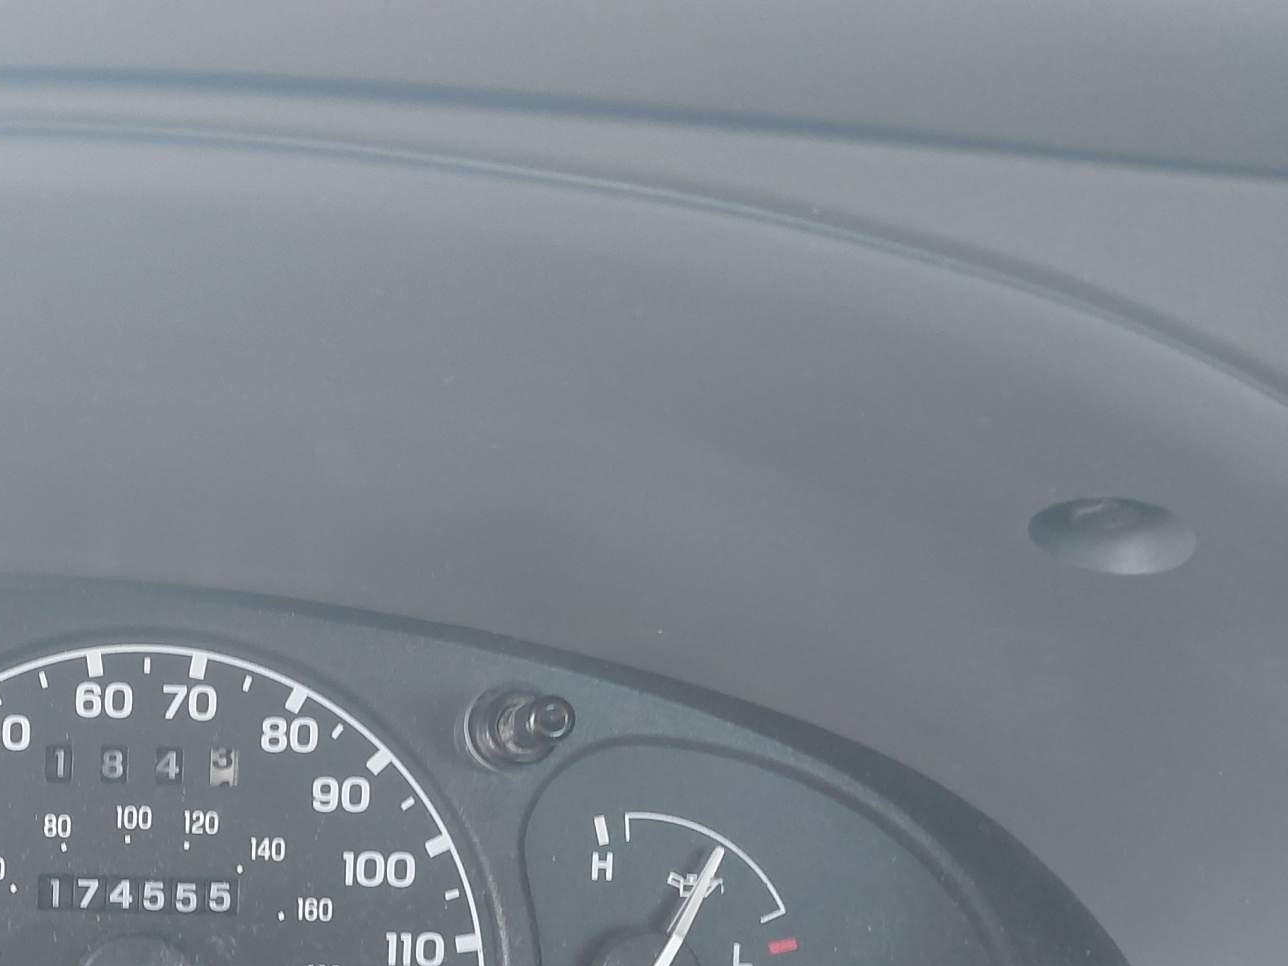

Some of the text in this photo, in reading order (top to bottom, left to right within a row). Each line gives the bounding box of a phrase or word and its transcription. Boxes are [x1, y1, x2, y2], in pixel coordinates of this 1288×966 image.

[75, 682, 133, 718] 60
[163, 685, 217, 721] 70
[261, 717, 318, 753] 80
[312, 777, 370, 813] 90
[44, 813, 72, 838] 80
[116, 805, 152, 830] 100
[184, 810, 219, 835] 120
[250, 838, 285, 861] 140
[592, 851, 613, 880] H
[343, 851, 415, 888] 100
[50, 877, 231, 913] 174555
[297, 898, 333, 922] 160
